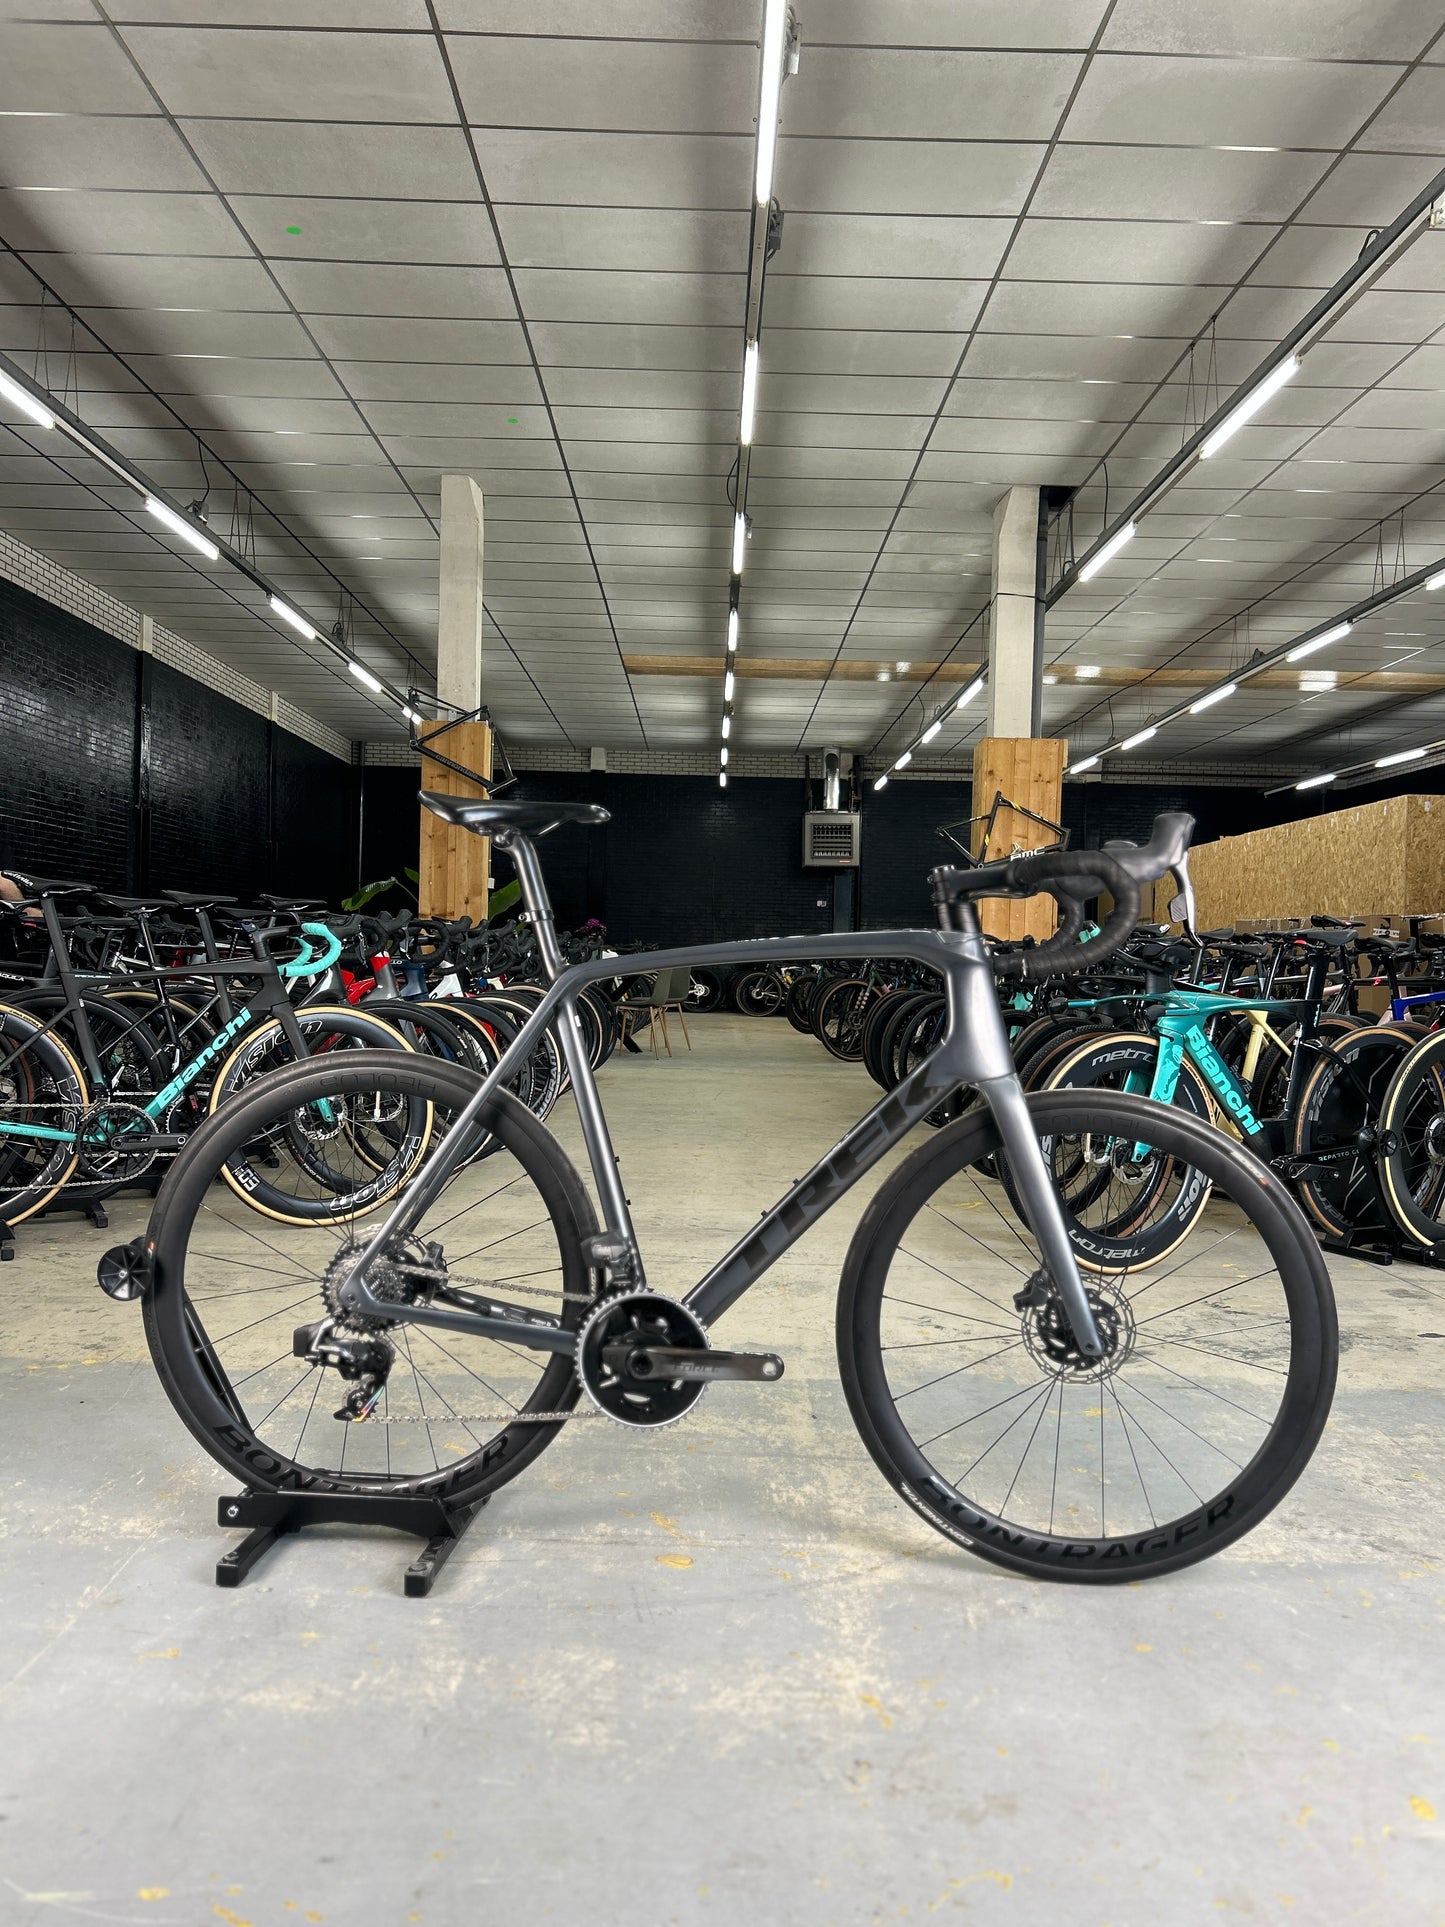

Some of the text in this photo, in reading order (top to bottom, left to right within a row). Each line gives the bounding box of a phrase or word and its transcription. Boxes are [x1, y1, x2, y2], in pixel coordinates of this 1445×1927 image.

[155, 1006, 252, 1109] Bianchi
[1186, 1024, 1264, 1136] Bianchi
[722, 1062, 949, 1275] TREK
[901, 1482, 973, 1546] CONTINENTAL
[919, 1474, 1234, 1562] BONTRAGER
